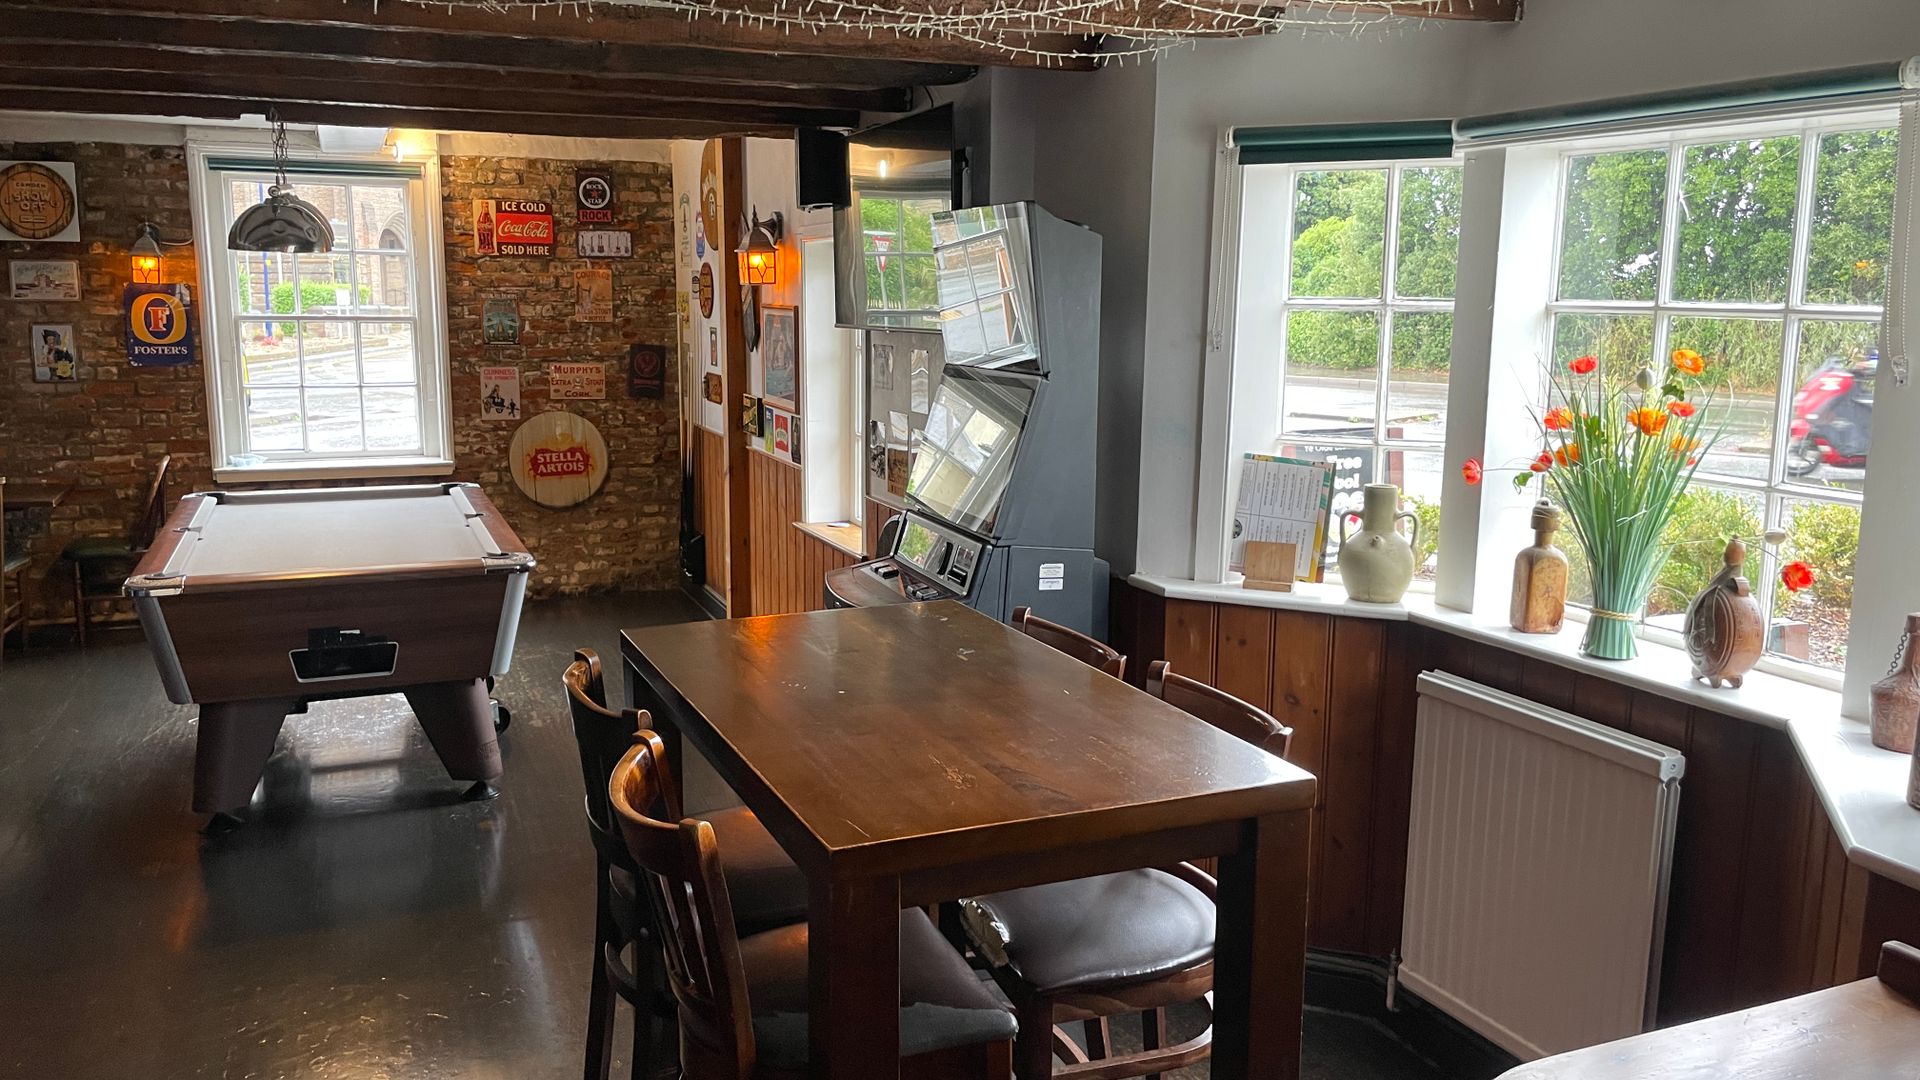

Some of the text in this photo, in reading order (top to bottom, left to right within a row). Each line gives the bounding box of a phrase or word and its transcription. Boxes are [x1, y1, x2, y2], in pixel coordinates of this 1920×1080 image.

[13, 190, 51, 202] SHOW
[20, 201, 46, 211] OFF
[501, 201, 546, 213] ICE COLD
[581, 210, 610, 220] ROCK
[501, 245, 550, 256] SOLD HERE
[148, 306, 170, 331] F
[134, 346, 188, 355] FOSTER'S
[537, 451, 583, 463] STELLA
[537, 461, 585, 474] ARTOIS
